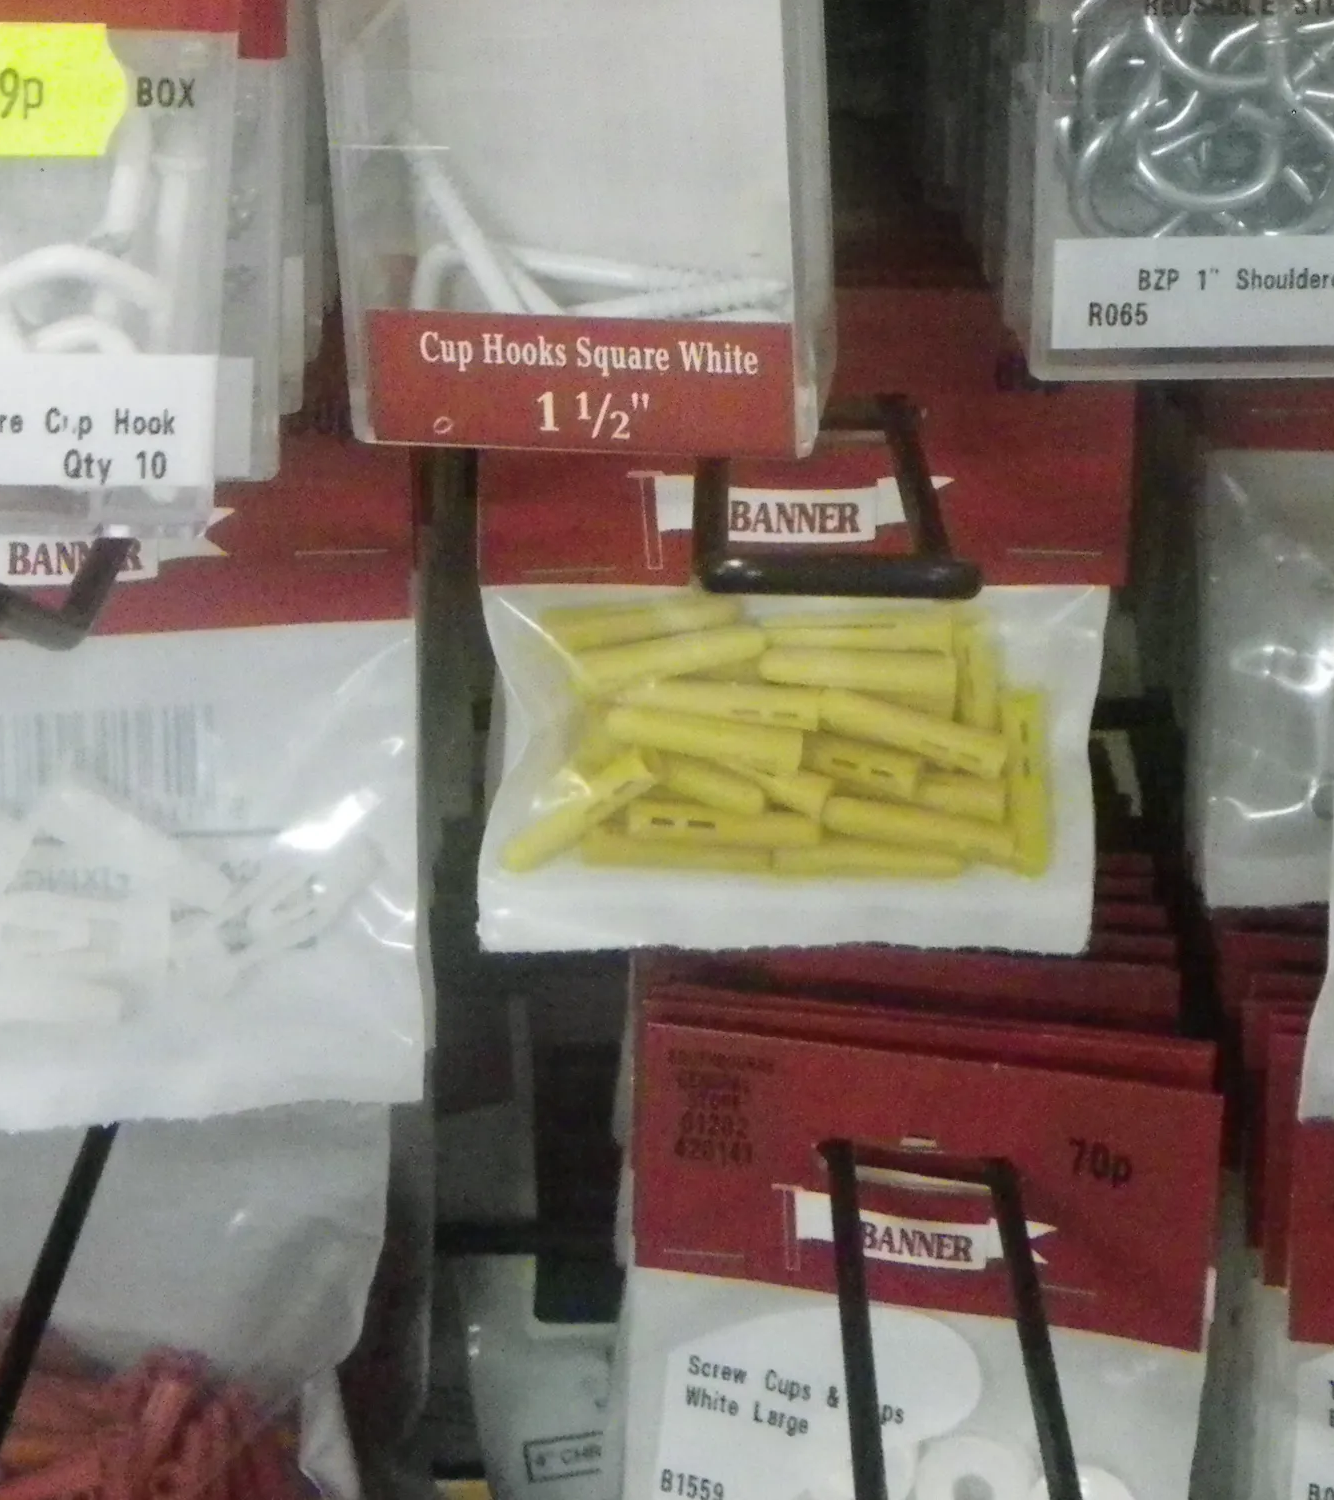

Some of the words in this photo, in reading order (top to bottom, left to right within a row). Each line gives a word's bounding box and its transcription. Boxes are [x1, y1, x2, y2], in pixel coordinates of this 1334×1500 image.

[136, 76, 196, 109] BOX
[1138, 268, 1180, 292] BZP
[1088, 302, 1148, 326] R065
[419, 330, 473, 373] Cup
[482, 332, 568, 368] Hooks
[576, 336, 670, 377] Square
[678, 341, 759, 376] White
[113, 408, 176, 437] Hook
[63, 449, 112, 484] Qty
[136, 450, 168, 479] 10
[730, 500, 861, 534] BANNER
[8, 540, 144, 576] BANR
[863, 1221, 973, 1262] BANNER
[688, 1355, 747, 1384] Screw
[765, 1369, 811, 1401] Cups
[827, 1385, 840, 1409] &
[685, 1384, 739, 1417] White
[753, 1401, 809, 1437] Large
